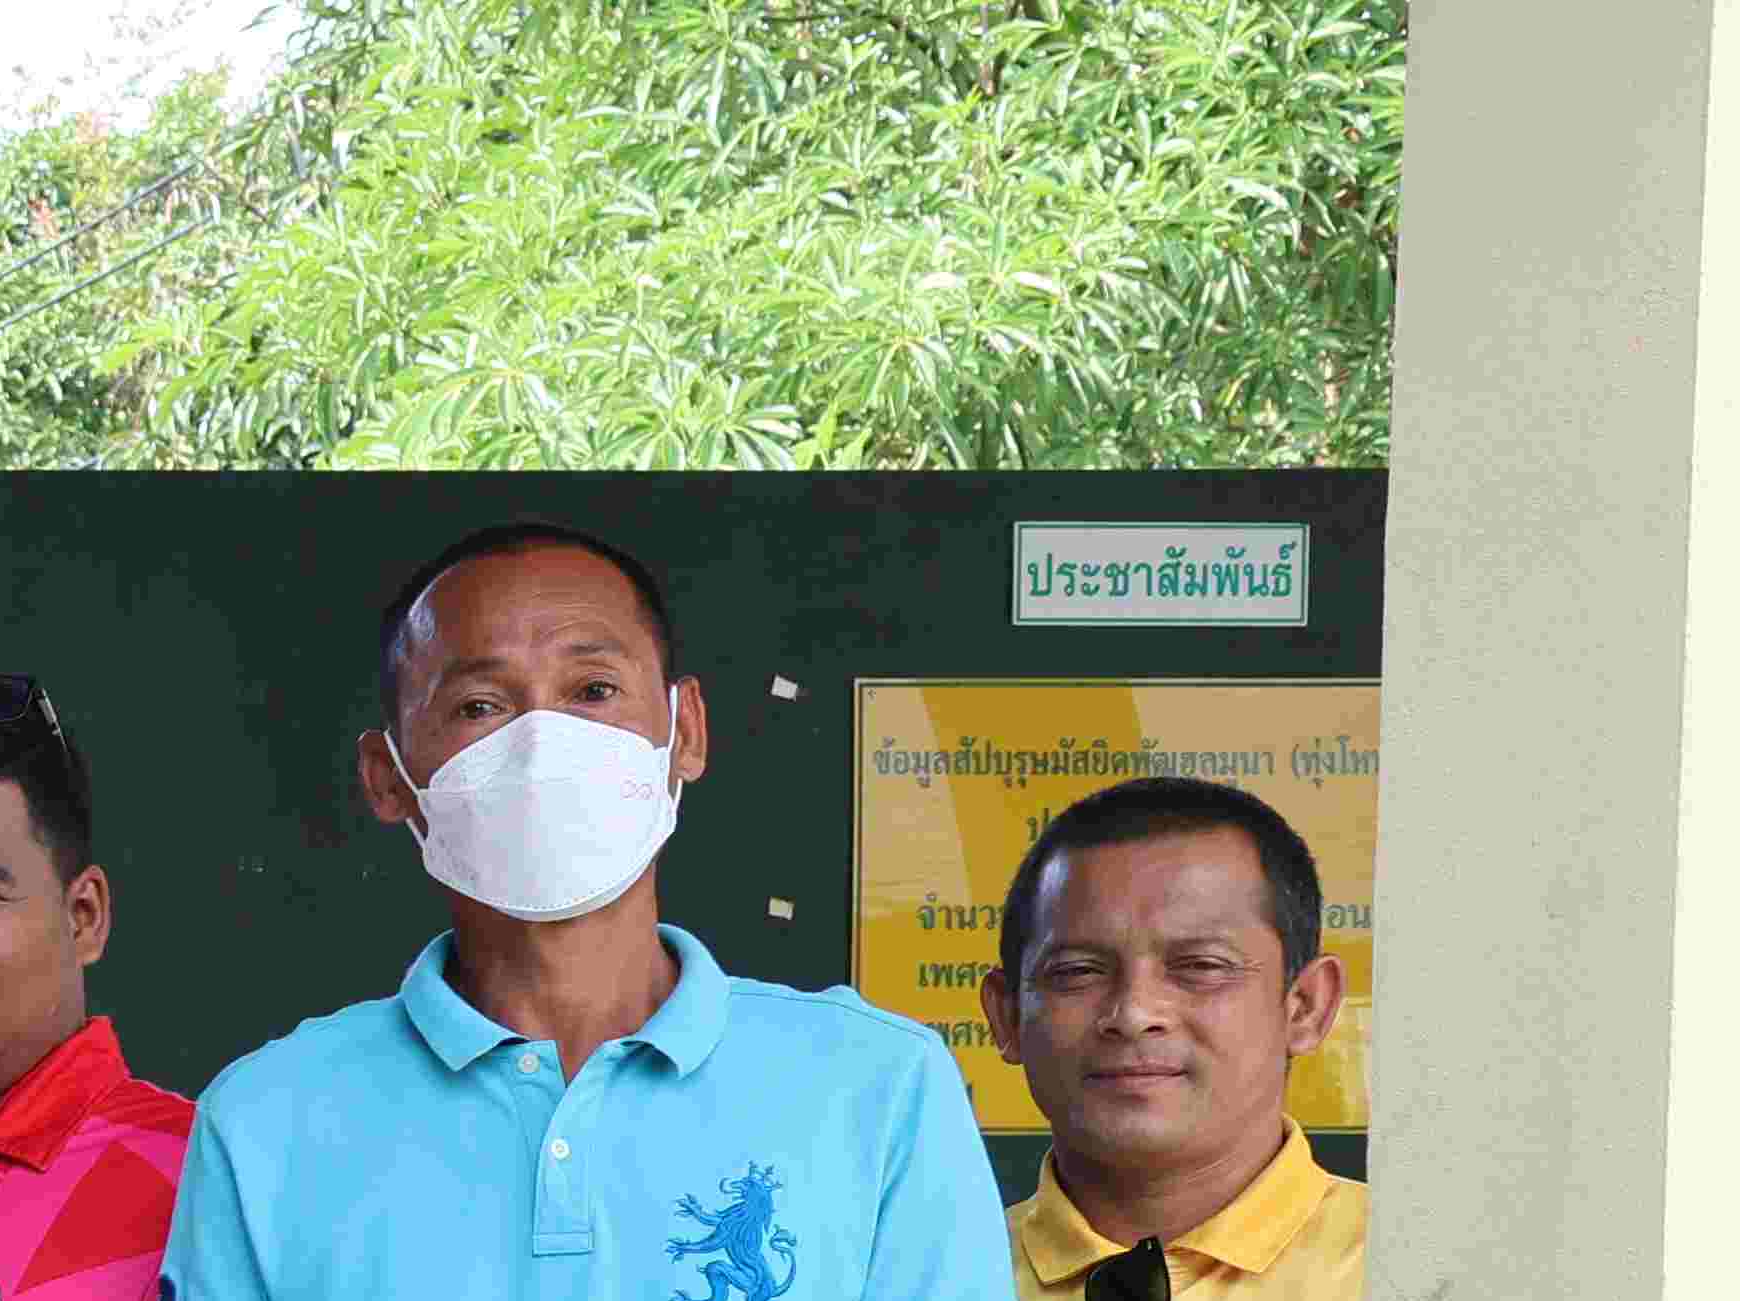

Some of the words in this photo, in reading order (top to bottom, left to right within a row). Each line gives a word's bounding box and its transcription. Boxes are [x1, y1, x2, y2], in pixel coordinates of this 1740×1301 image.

[1027, 541, 1298, 598] ประชาสัมพันธ์
